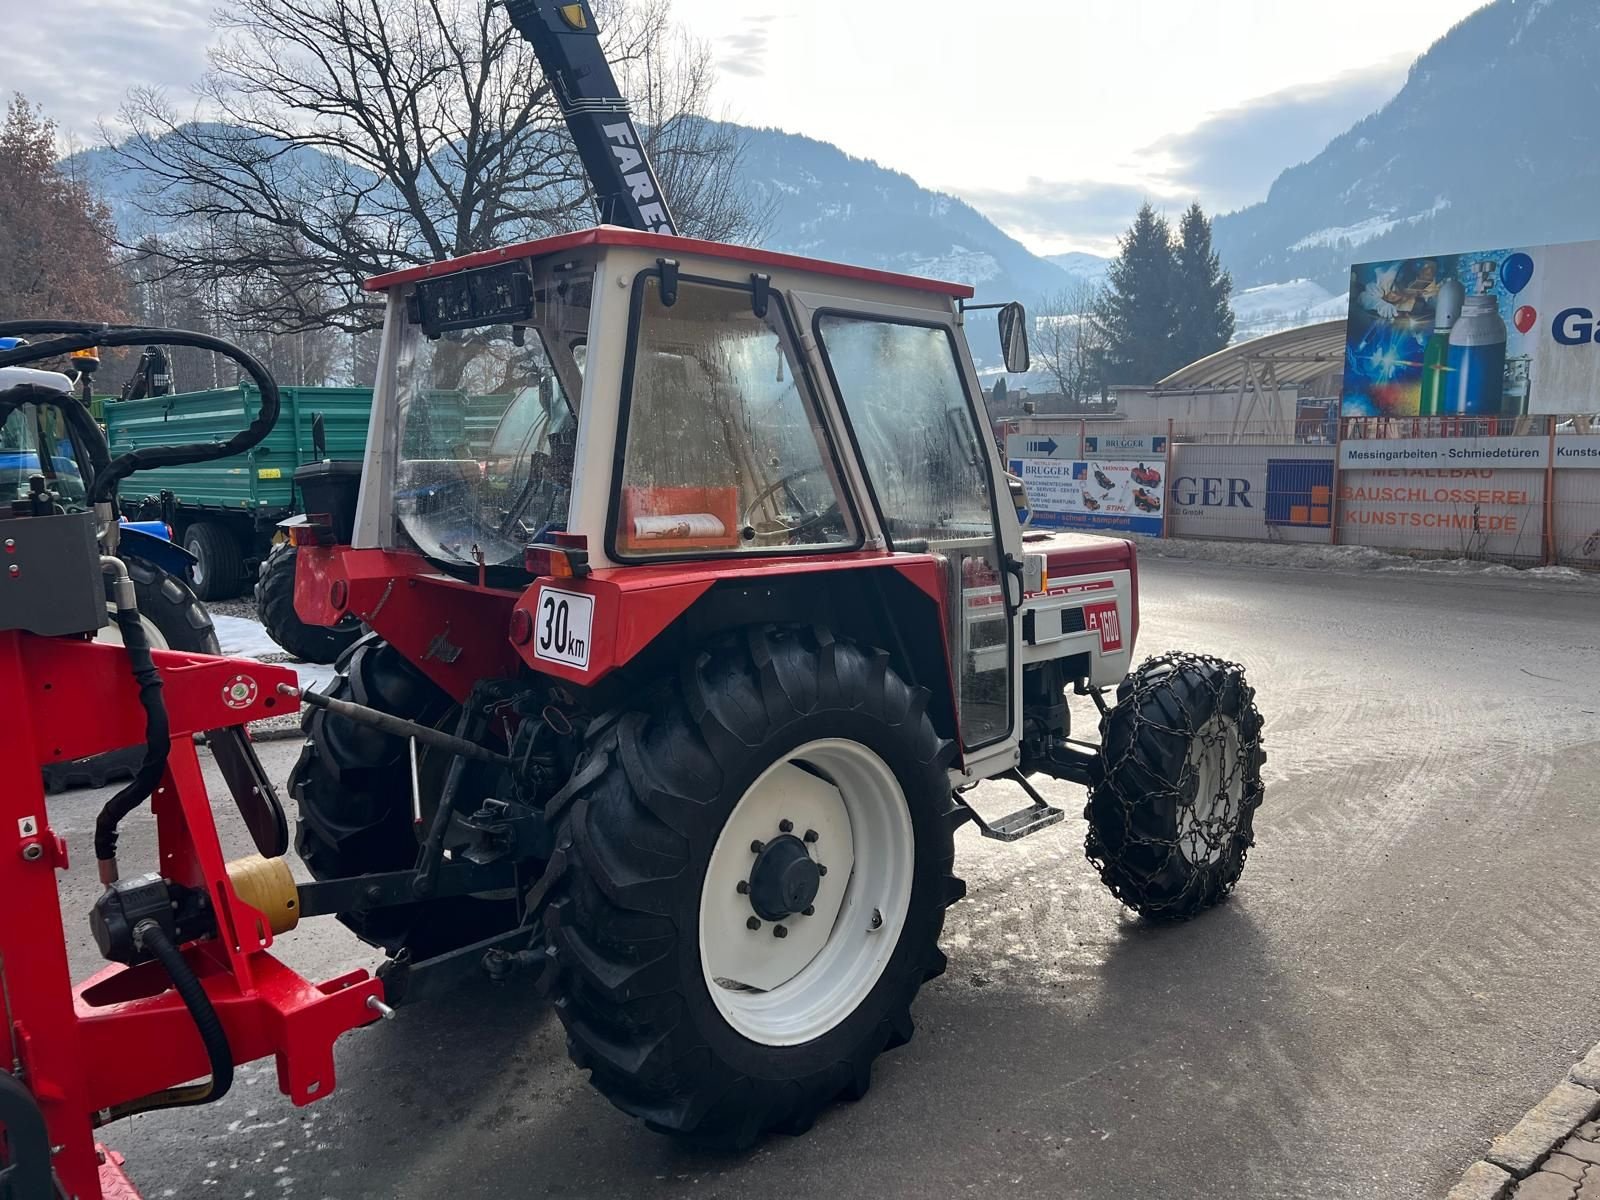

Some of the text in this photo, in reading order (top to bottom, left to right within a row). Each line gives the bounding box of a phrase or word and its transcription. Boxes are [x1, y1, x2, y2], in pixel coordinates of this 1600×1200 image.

[1551, 307, 1600, 345] G
[1348, 449, 1438, 461] Messingarbeiten
[1448, 447, 1540, 459] Schmiedetüren
[1025, 465, 1070, 476] BRUGGER
[1340, 487, 1527, 504] BAUSCHLOSSEREI
[1344, 510, 1518, 531] KUNSTSCHMIEDE
[541, 596, 585, 659] 30 km
[1089, 609, 1120, 644] A 1600
